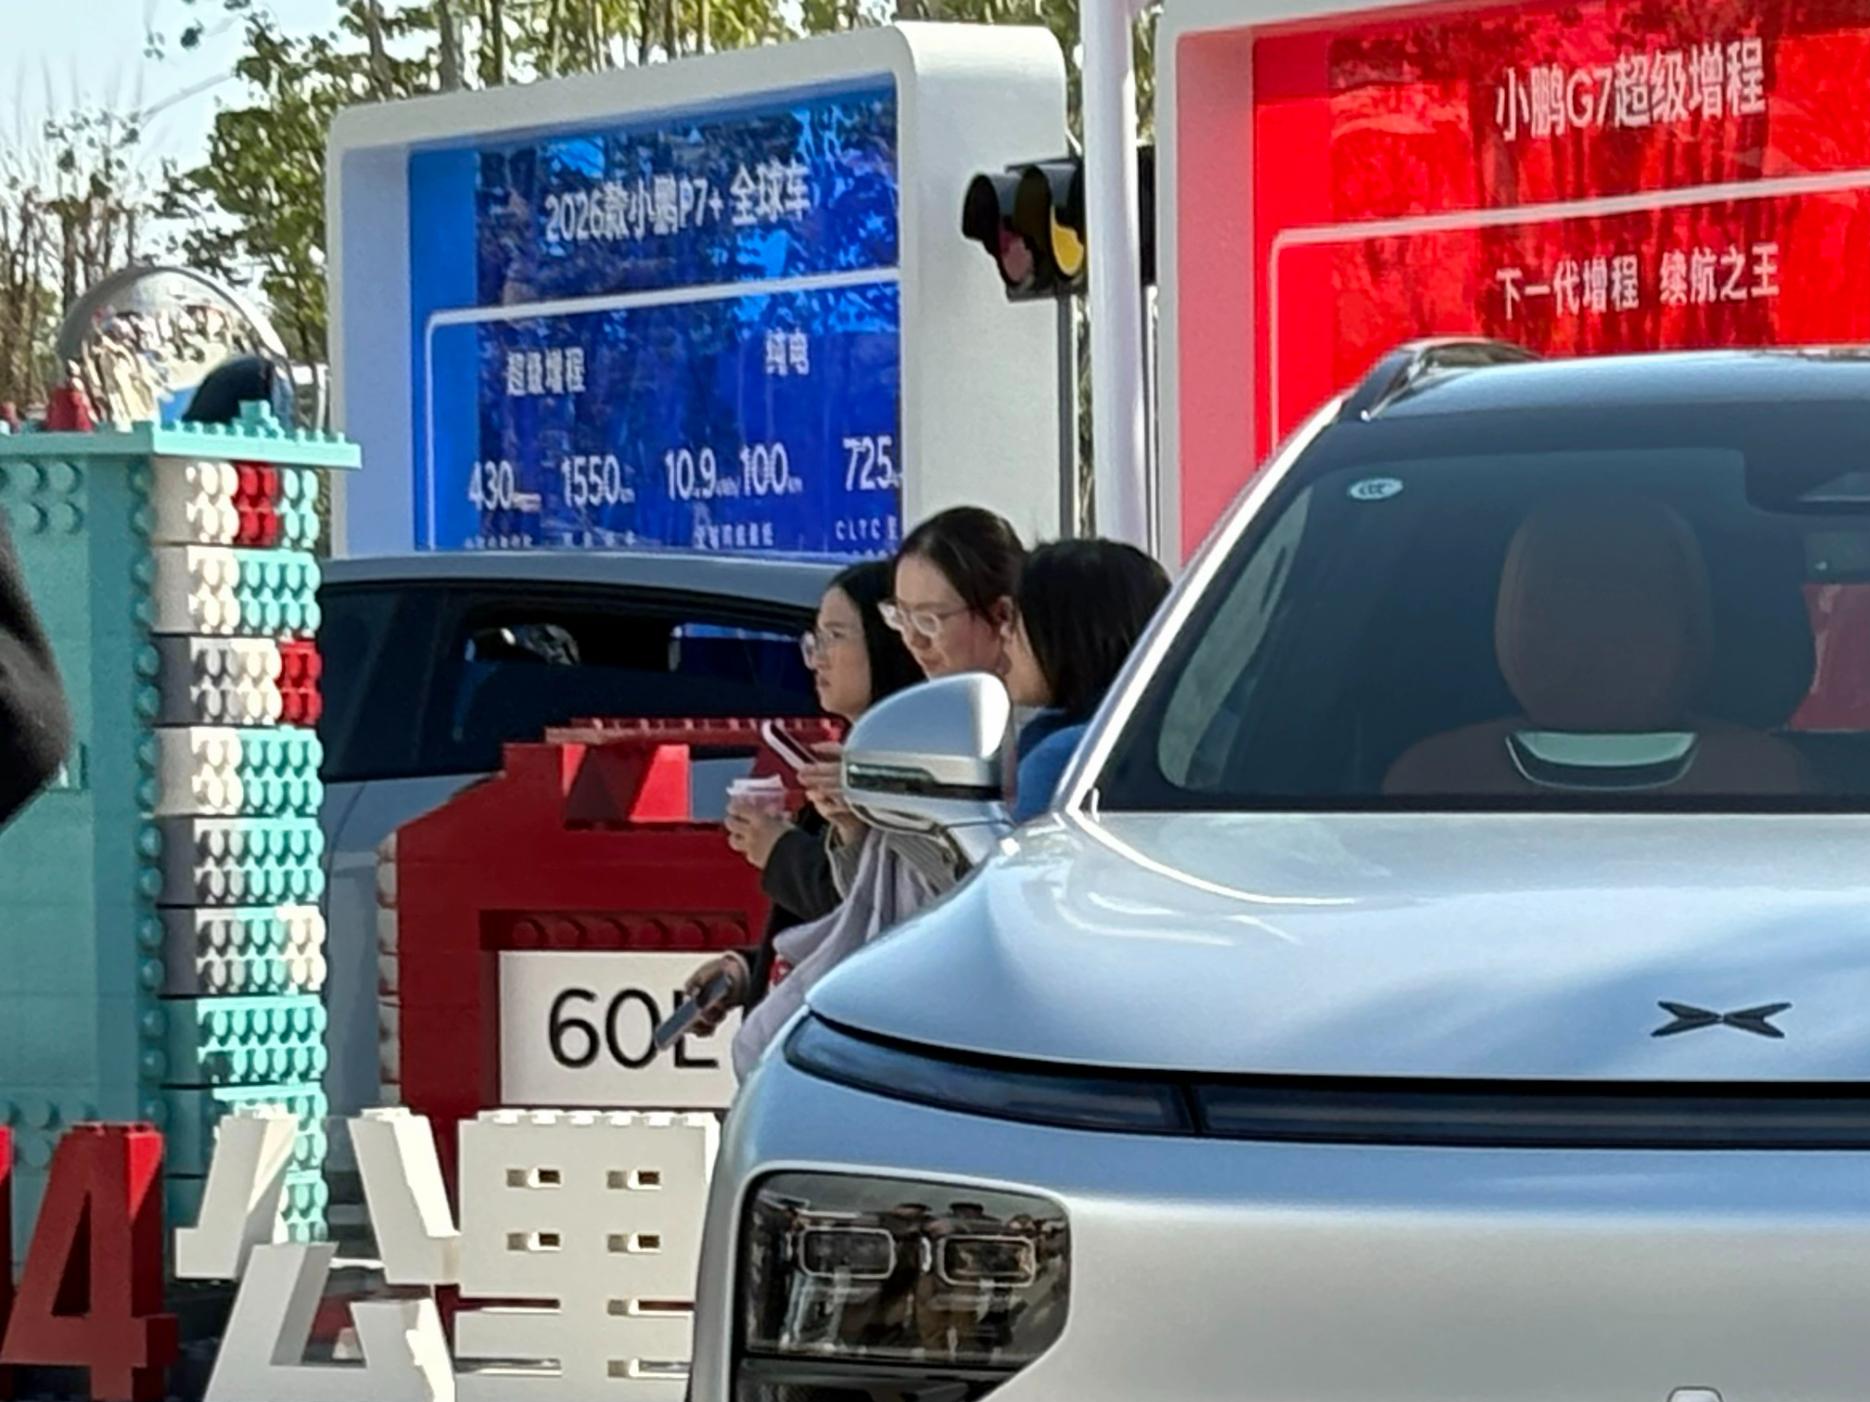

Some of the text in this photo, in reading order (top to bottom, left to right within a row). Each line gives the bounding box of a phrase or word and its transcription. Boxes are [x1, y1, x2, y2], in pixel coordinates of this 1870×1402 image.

[1495, 37, 1766, 140] 小鹏G7超级增程
[729, 156, 811, 226] 全球车
[1496, 242, 1781, 321] 下一代增程 续航之王
[504, 346, 586, 396] 超级增程
